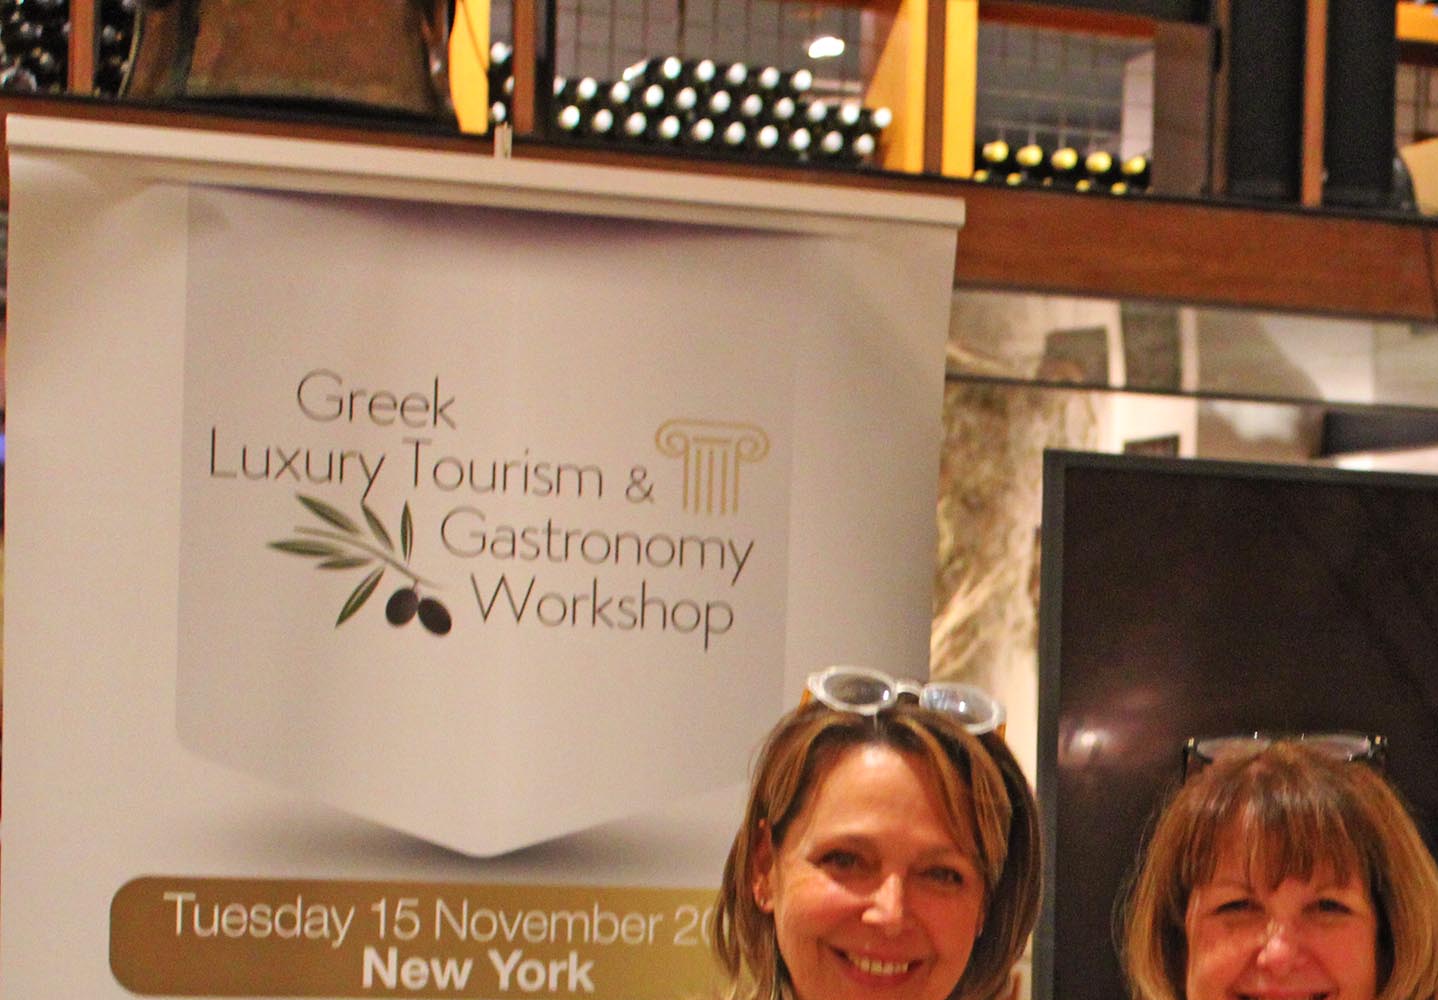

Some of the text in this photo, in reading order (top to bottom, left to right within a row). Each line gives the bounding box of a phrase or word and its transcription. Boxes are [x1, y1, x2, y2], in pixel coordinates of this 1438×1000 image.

[297, 367, 456, 430] Greek
[209, 426, 655, 506] Luxury Tourism &
[440, 505, 755, 587] Gastronomy
[469, 572, 734, 651] Workshop
[163, 890, 356, 949] Tuesday
[370, 896, 421, 941] 15
[435, 896, 664, 946] November
[362, 945, 596, 993] New York
